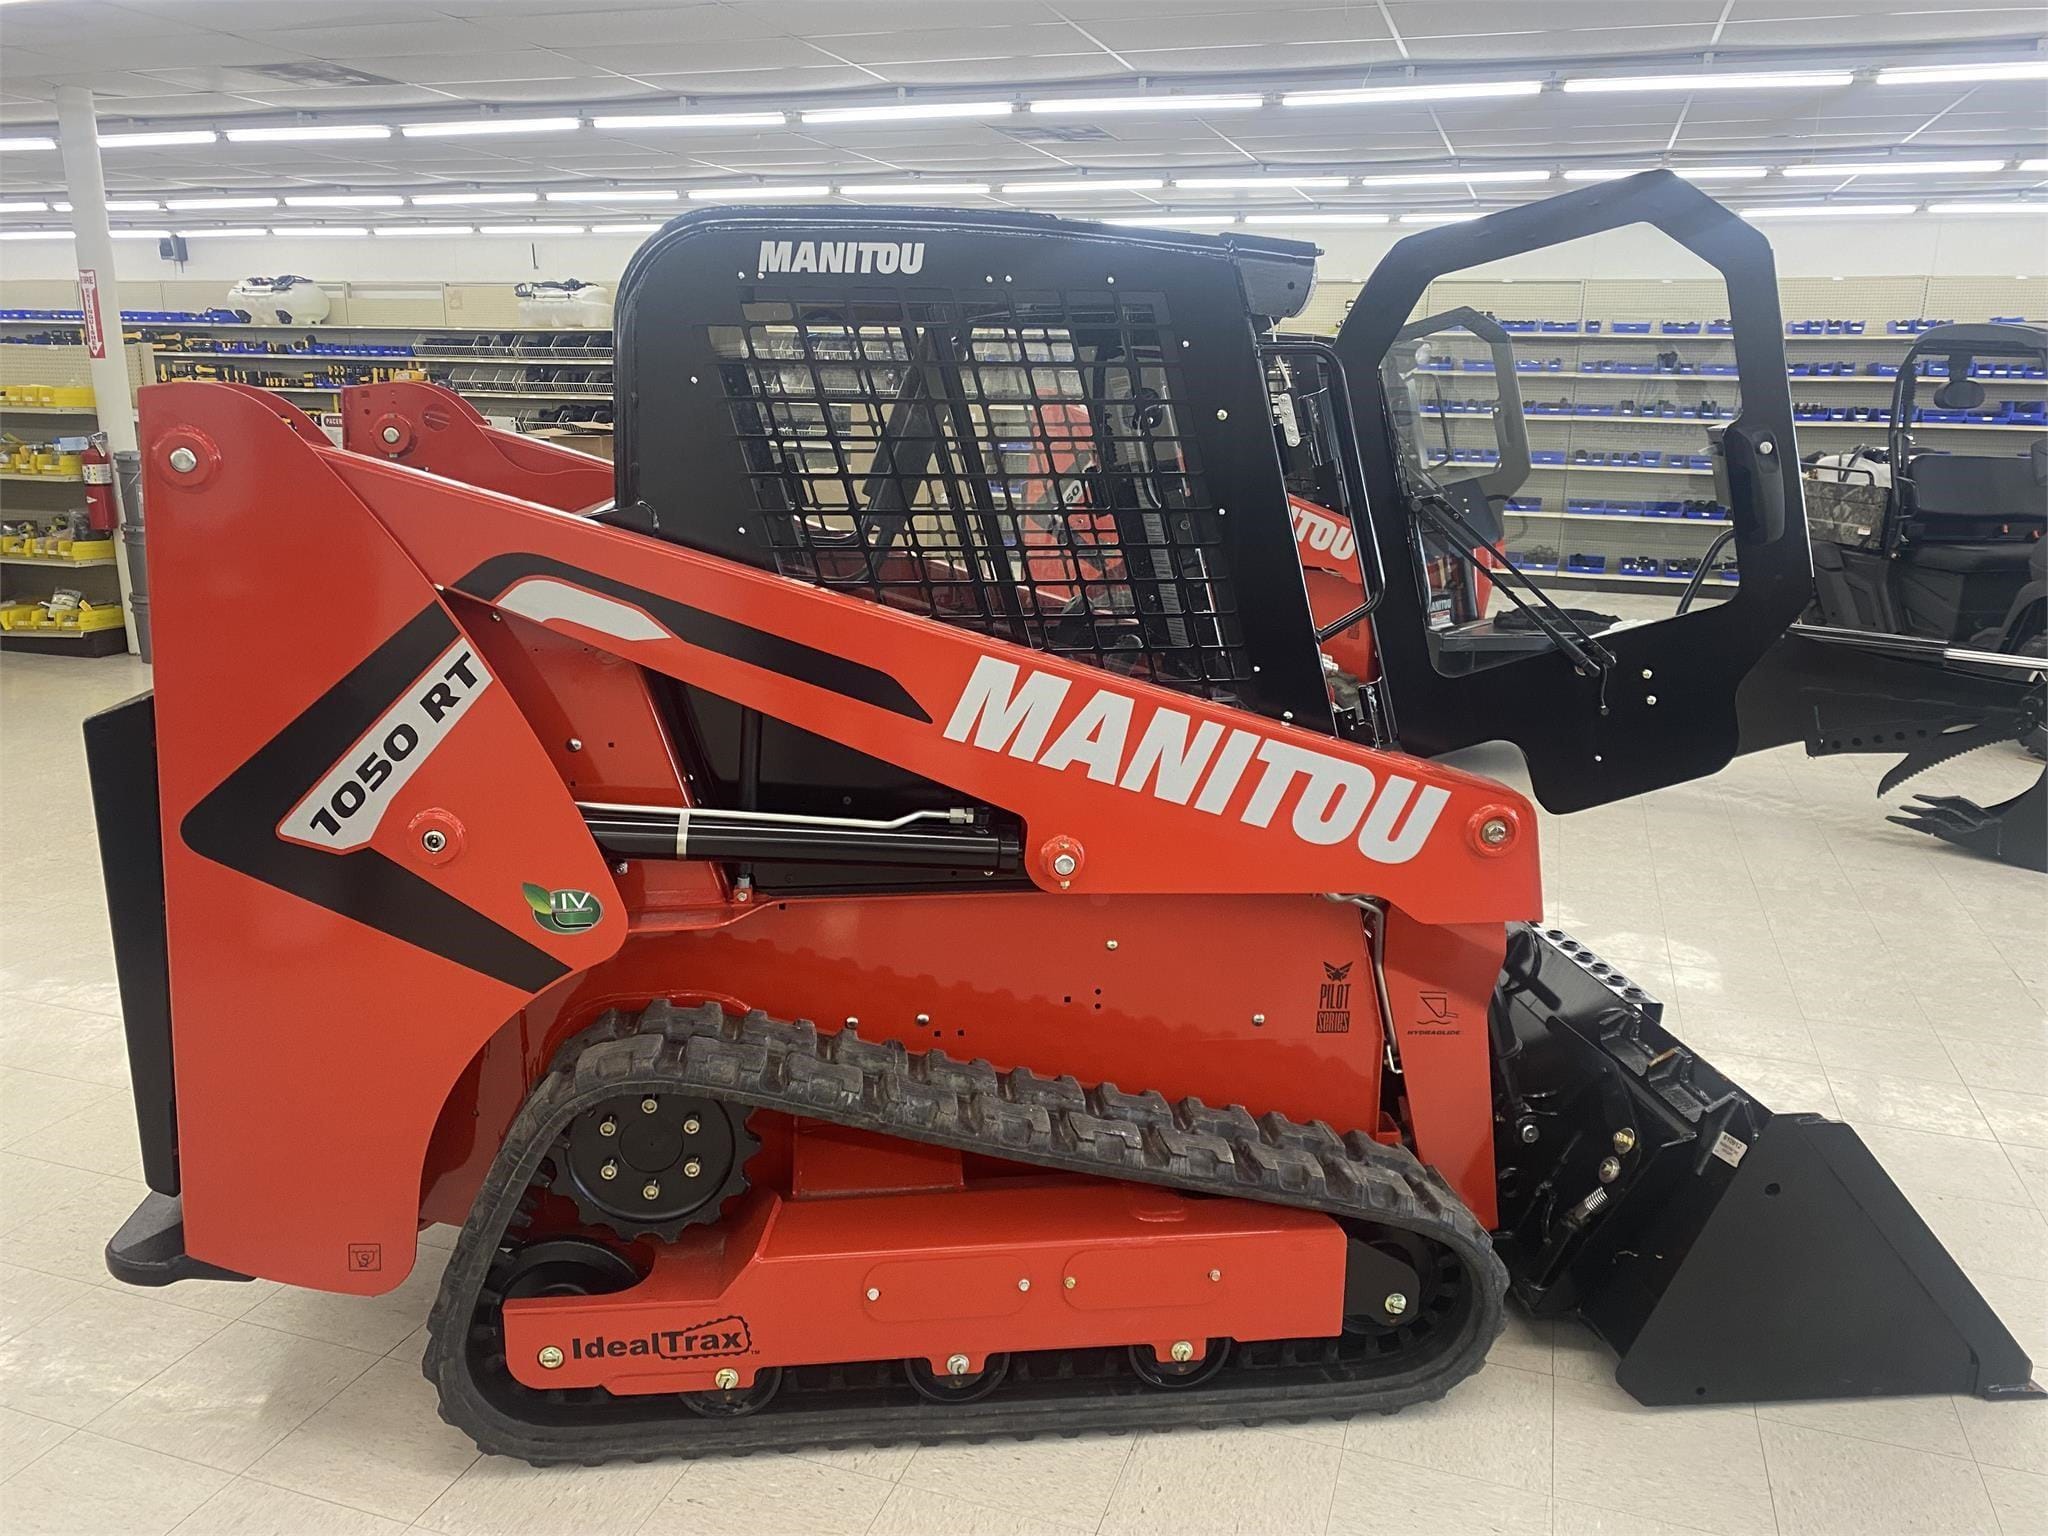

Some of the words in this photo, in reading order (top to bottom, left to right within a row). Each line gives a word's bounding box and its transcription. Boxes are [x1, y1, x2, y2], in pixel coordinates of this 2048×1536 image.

[758, 240, 925, 275] MANITOU
[309, 723, 419, 836] 1050
[419, 650, 478, 723] RT
[942, 654, 1452, 865] MANITOU
[1319, 983, 1352, 1009] PILOT
[572, 1331, 742, 1359] IdealTrax
